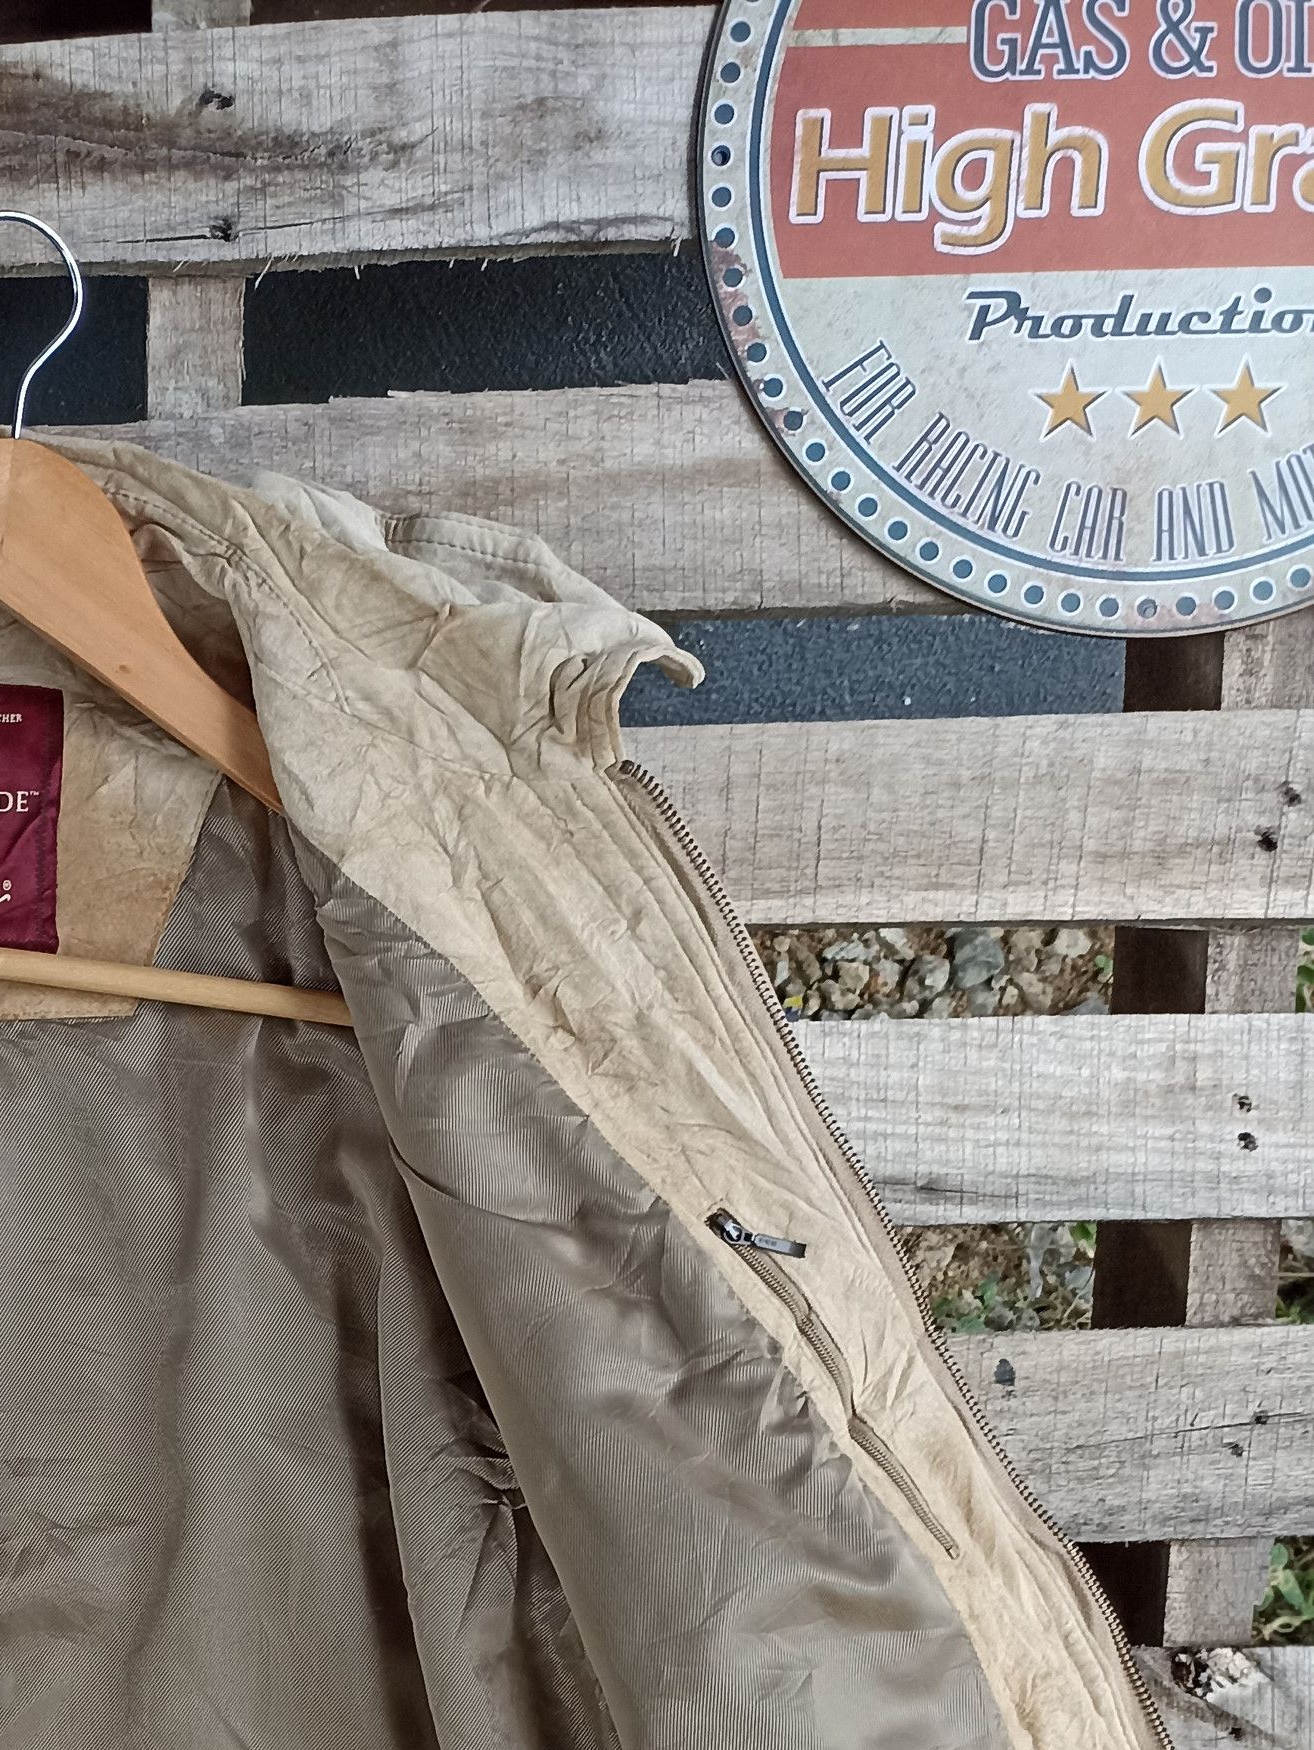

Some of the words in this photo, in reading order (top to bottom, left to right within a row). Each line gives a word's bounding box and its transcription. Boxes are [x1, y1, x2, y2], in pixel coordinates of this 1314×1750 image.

[970, 0, 1130, 80] GAS
[1149, 0, 1217, 79] &
[1235, 0, 1314, 79] OI
[788, 102, 1109, 256] High
[966, 285, 1314, 341] Productio
[820, 340, 918, 445] FOR
[891, 410, 1041, 542] RACING
[1048, 480, 1129, 562] CAR
[1152, 480, 1236, 563] AND
